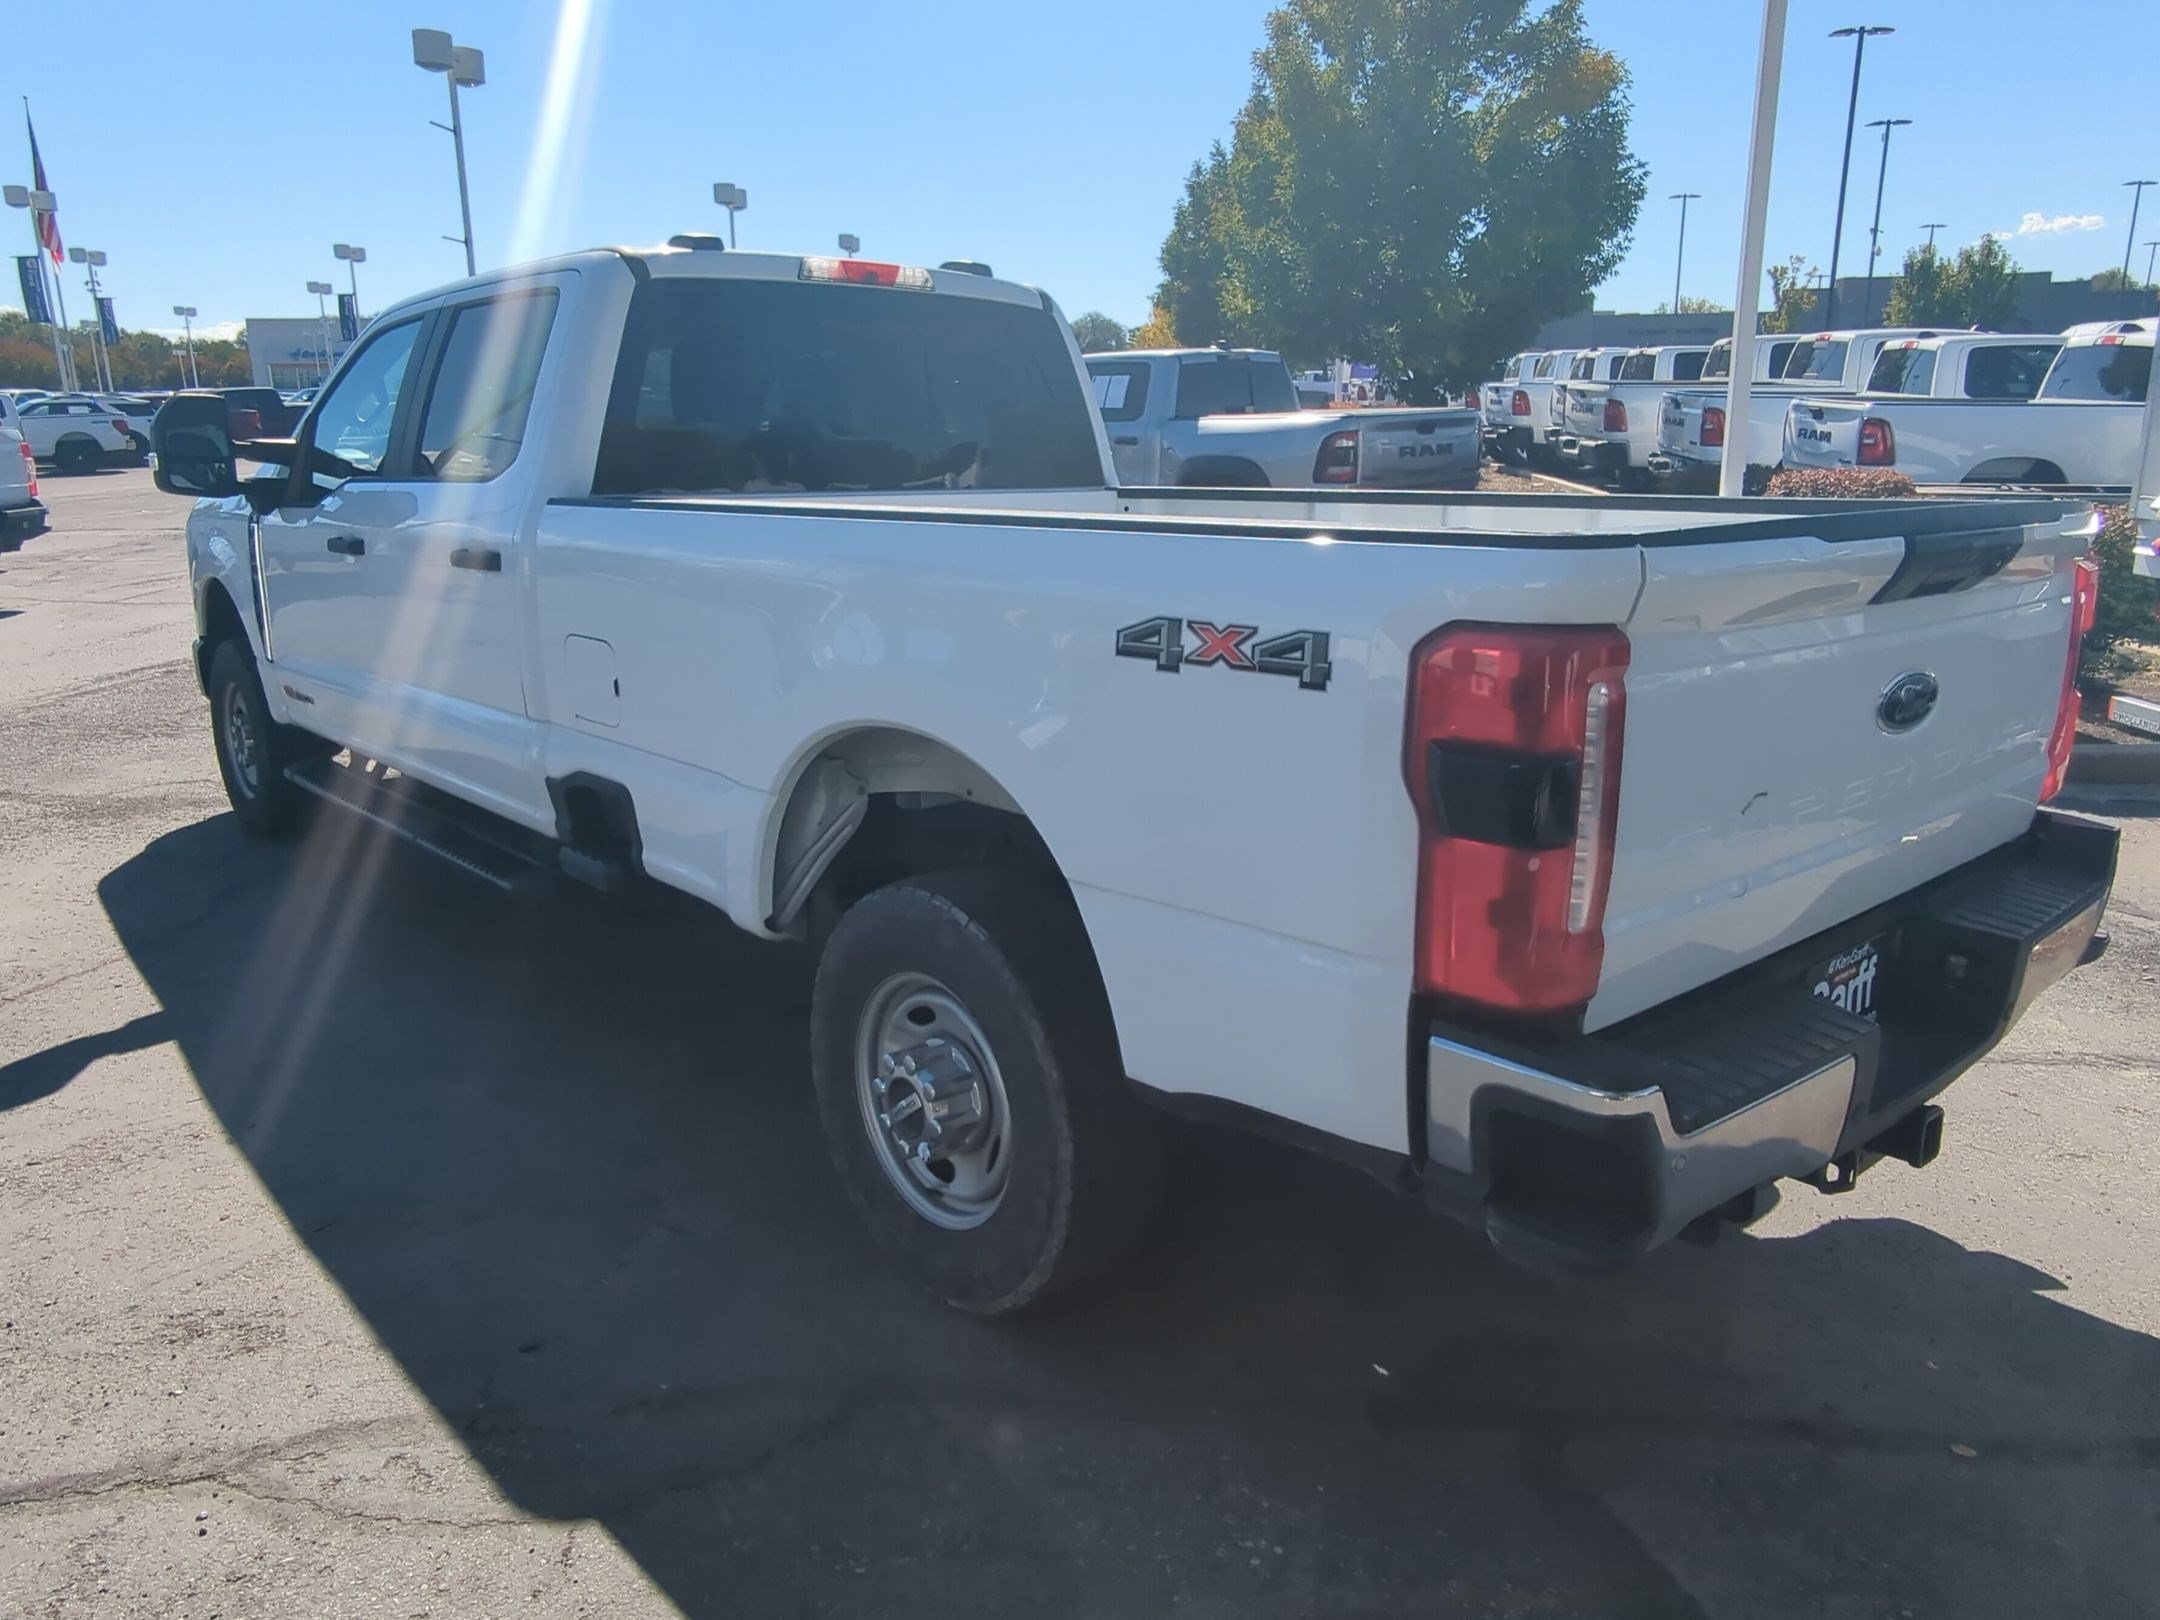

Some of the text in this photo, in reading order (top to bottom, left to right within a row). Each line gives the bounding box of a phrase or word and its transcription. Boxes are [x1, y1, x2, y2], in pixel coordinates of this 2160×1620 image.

[1571, 402, 1595, 416] RAM
[1797, 427, 1832, 443] RAM
[1398, 442, 1454, 459] RAM
